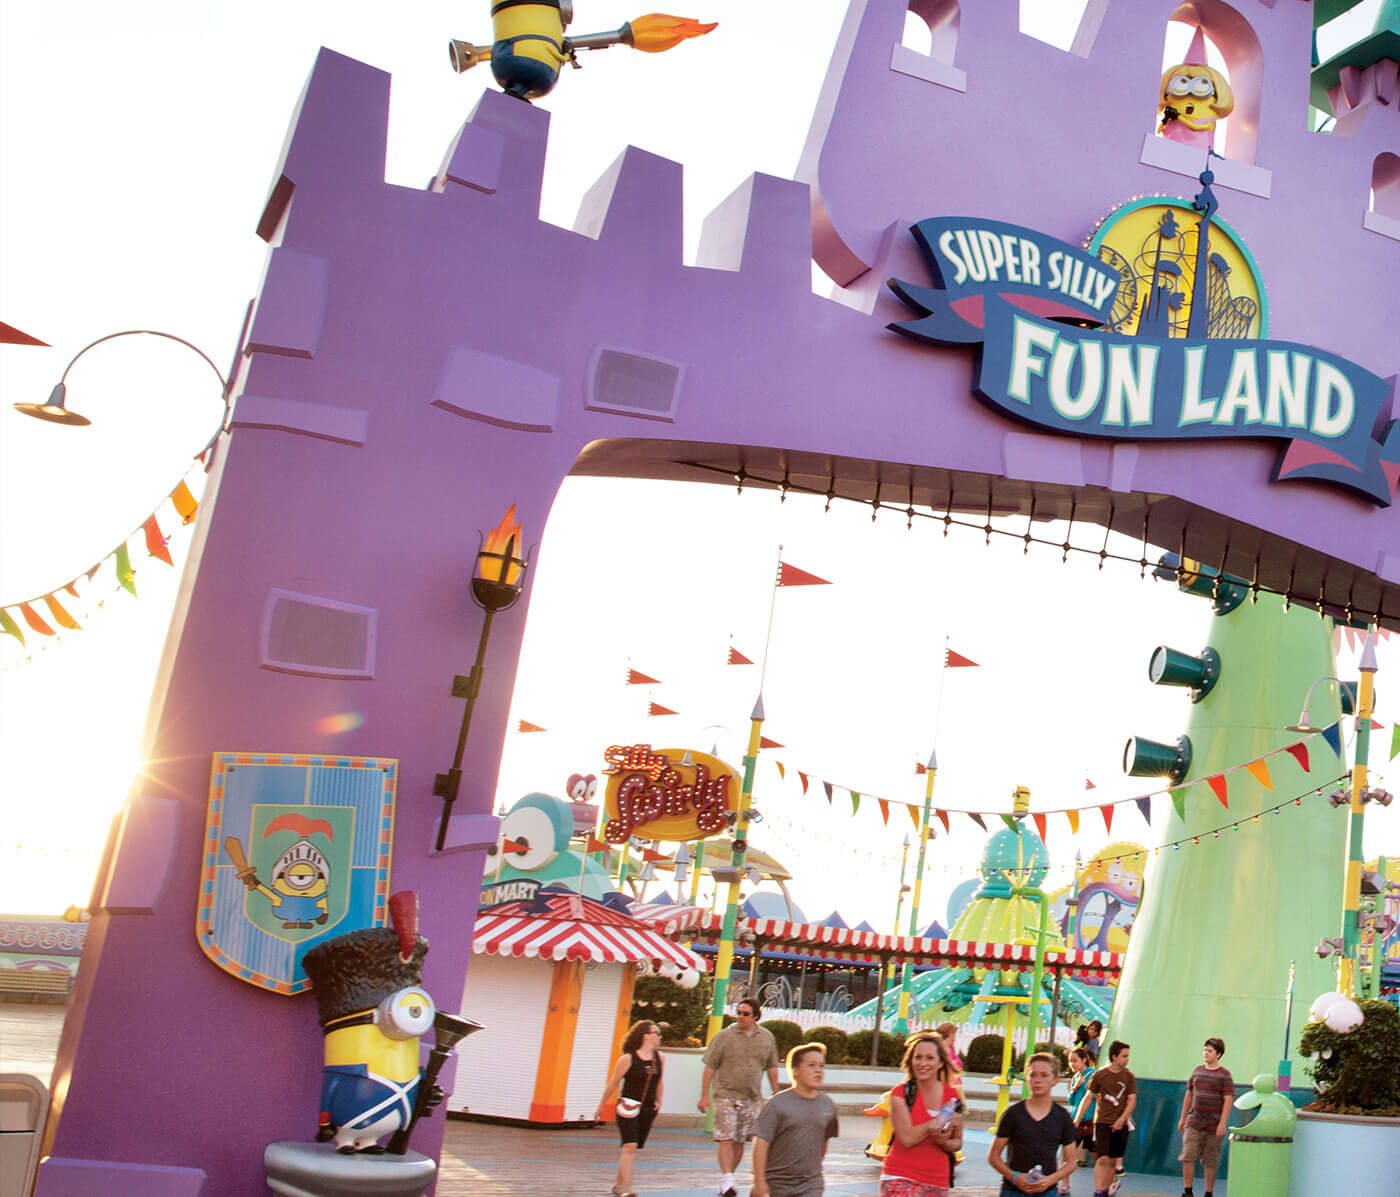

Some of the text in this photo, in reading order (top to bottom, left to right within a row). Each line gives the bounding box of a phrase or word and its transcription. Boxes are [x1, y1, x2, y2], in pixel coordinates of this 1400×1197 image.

[938, 228, 1117, 311] SUPER SILLY
[1007, 314, 1355, 438] FUN LAND
[601, 743, 669, 782] Silly
